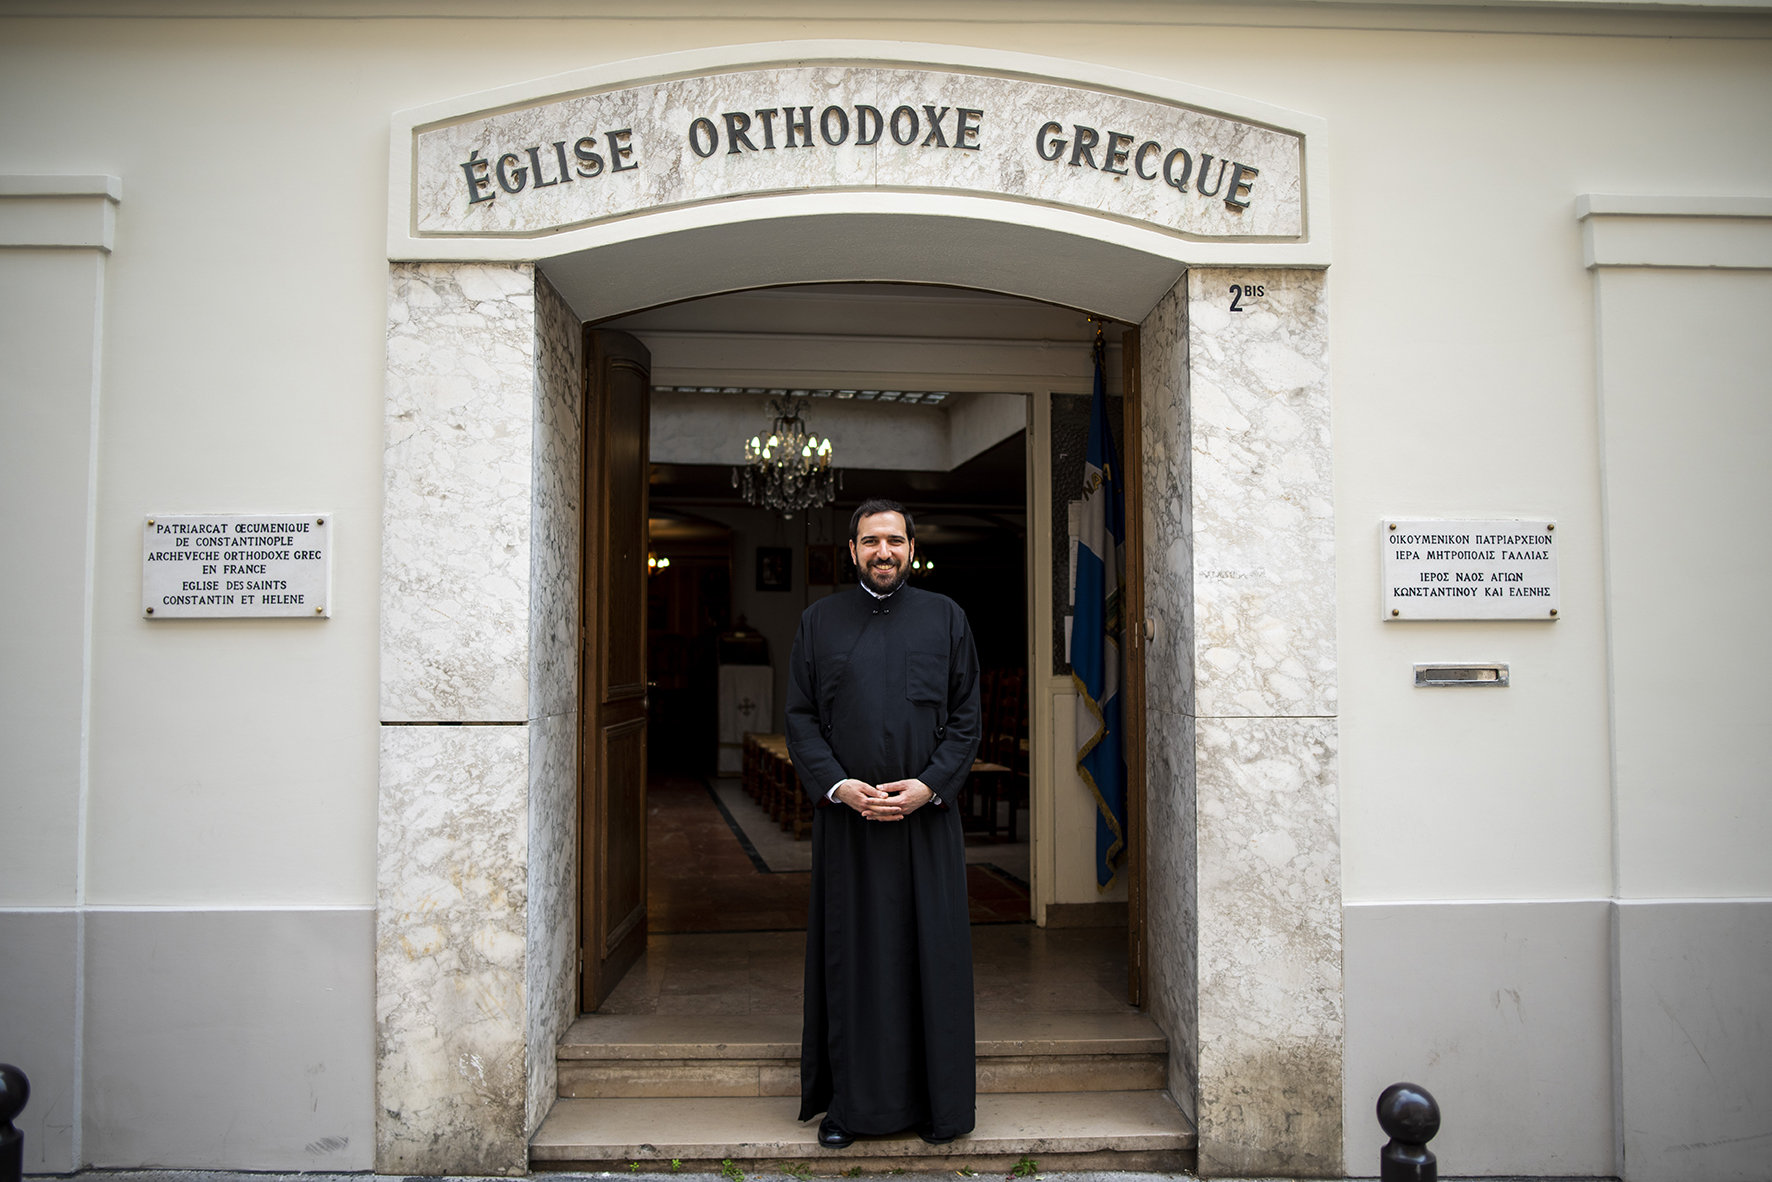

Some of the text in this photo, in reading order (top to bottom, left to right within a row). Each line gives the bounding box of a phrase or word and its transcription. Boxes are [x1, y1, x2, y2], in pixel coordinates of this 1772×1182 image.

[461, 104, 1260, 208] ÉGLISE ORTHODOXE GRECQUE
[157, 523, 309, 534] PATRIARCAT ŒCUMENIQUE
[176, 536, 293, 547] DE CONSTANTINOPLE
[1389, 535, 1552, 545] ΟΙΚΟΥΜΕΝΙΚΟΝ ΠΑΤΡΙΑΡΧΕΙΟΝ
[148, 551, 321, 561] ARCHEVECHE ORTHODOXE GREC
[1396, 551, 1549, 560] ΙΕΡΑ ΜΗΤΡΟΠΟΛΙΣ ΓΑΛΛΙΑΣ
[203, 565, 266, 574] EN FRANCE
[1420, 572, 1523, 582] ΙΕΡΟΣ ΝΑΟΣ ΑΓΙΩΝ
[183, 580, 287, 591] EGLISE DES SAINTS
[1394, 587, 1550, 597] ΚΩΝΣΤΑΝΤΙΝΟΥ ΚΑΙ ΕΛΕΝΗΣ
[163, 595, 304, 605] CONSTANTIN ET HELENE
